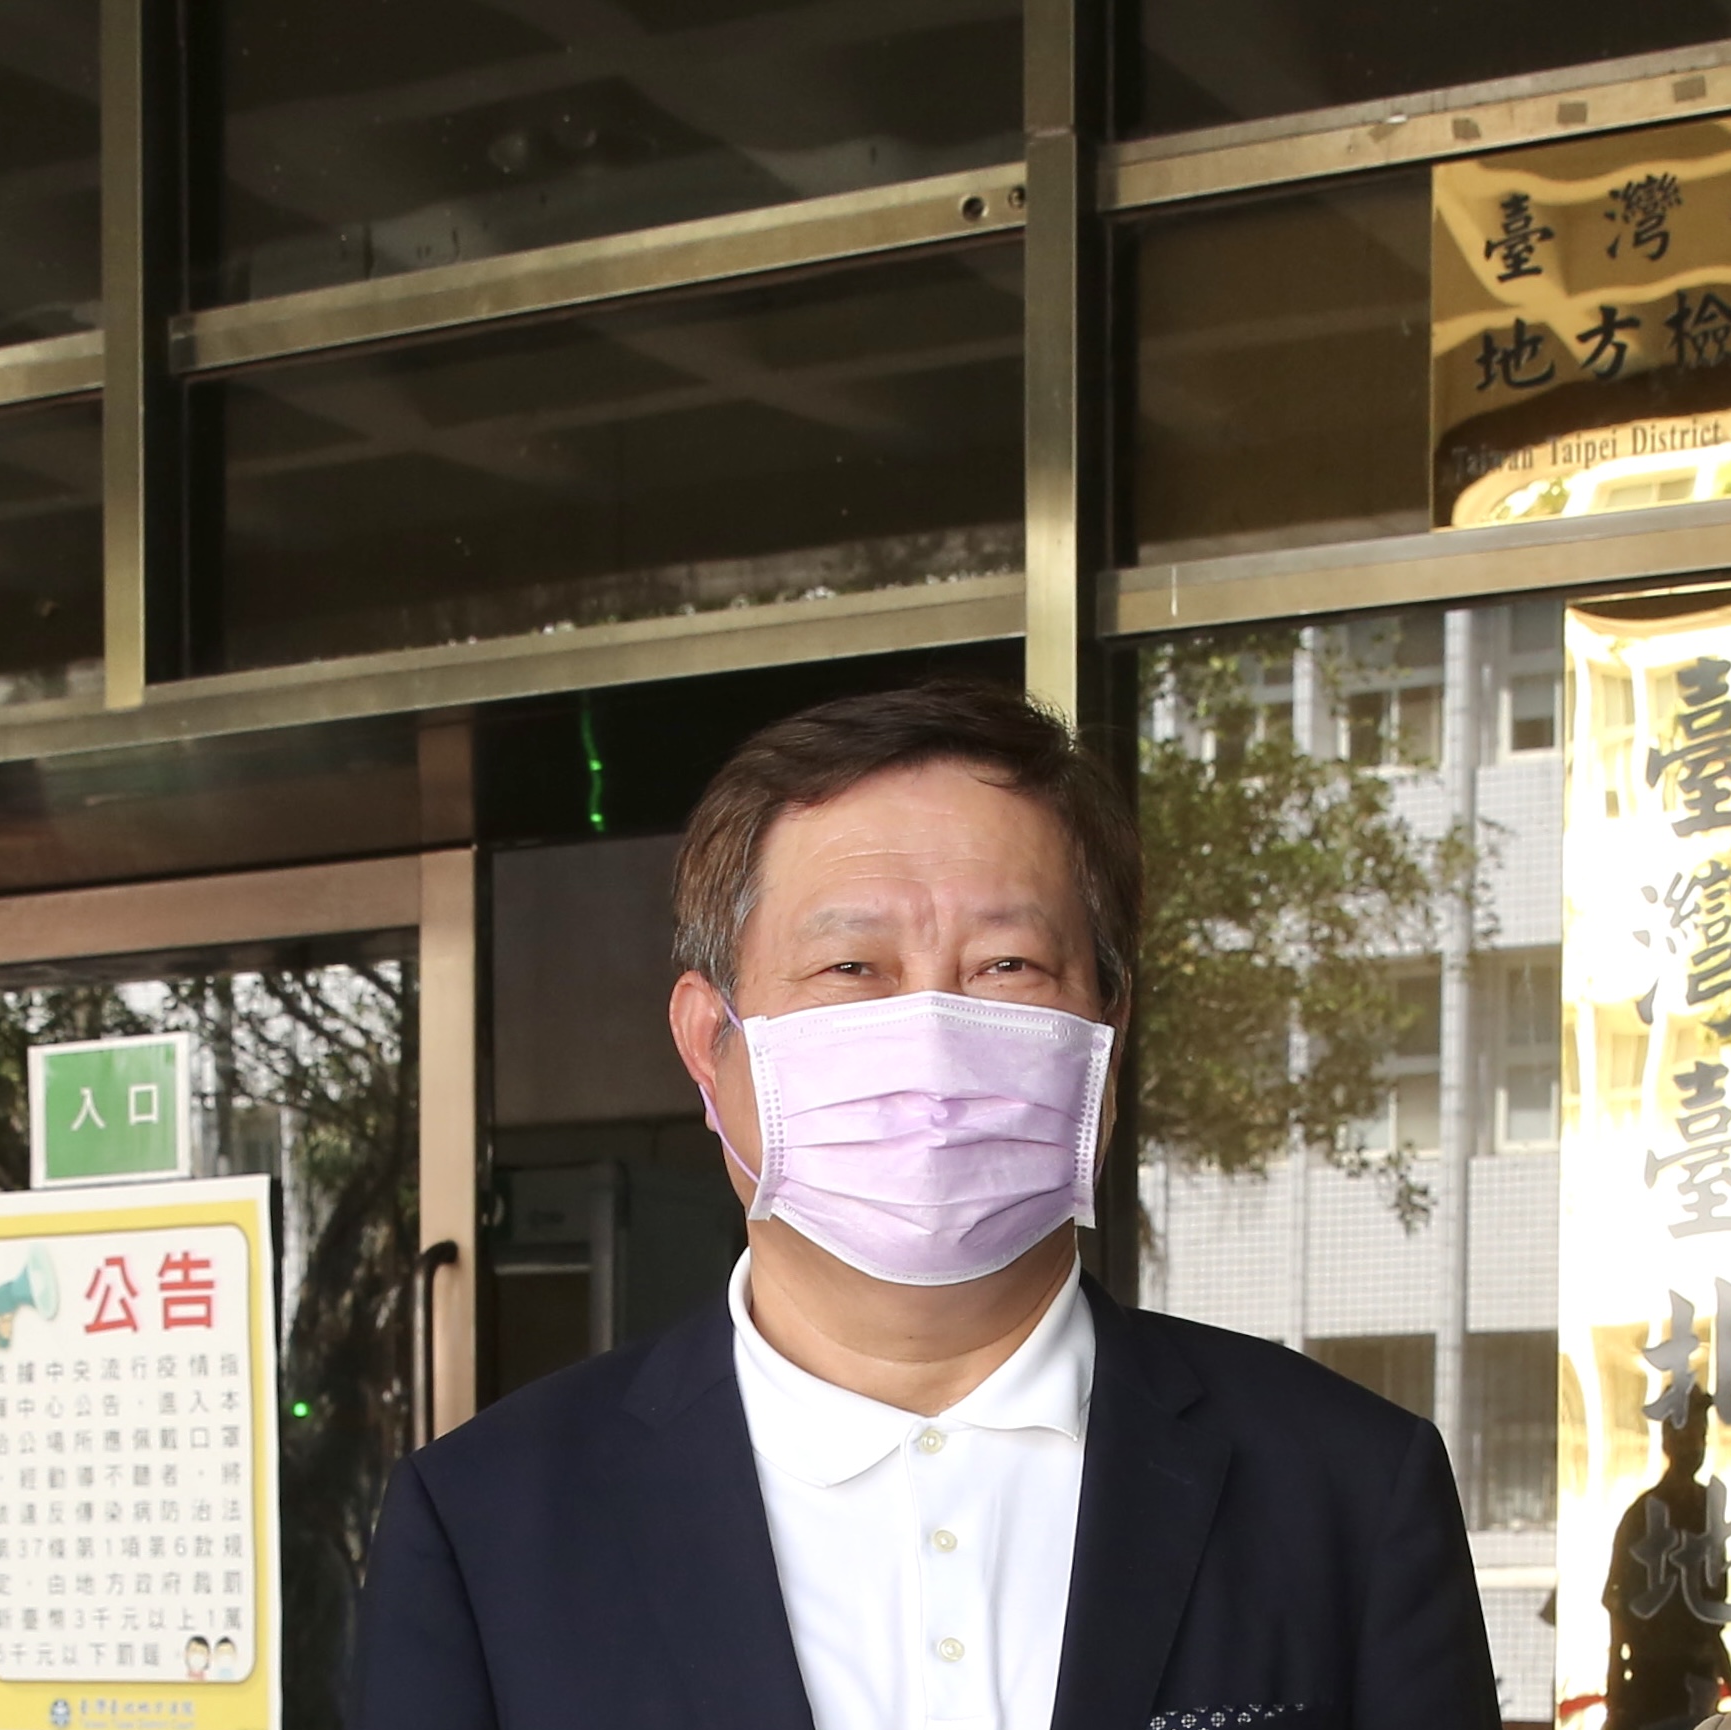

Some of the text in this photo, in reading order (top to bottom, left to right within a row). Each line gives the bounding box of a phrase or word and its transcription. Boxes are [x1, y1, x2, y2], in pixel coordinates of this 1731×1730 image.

[1451, 444, 1535, 475] Taiwan
[1549, 429, 1618, 469] Taipei
[1631, 414, 1722, 455] District
[71, 1084, 159, 1131] 入口
[84, 1251, 216, 1334] 公告
